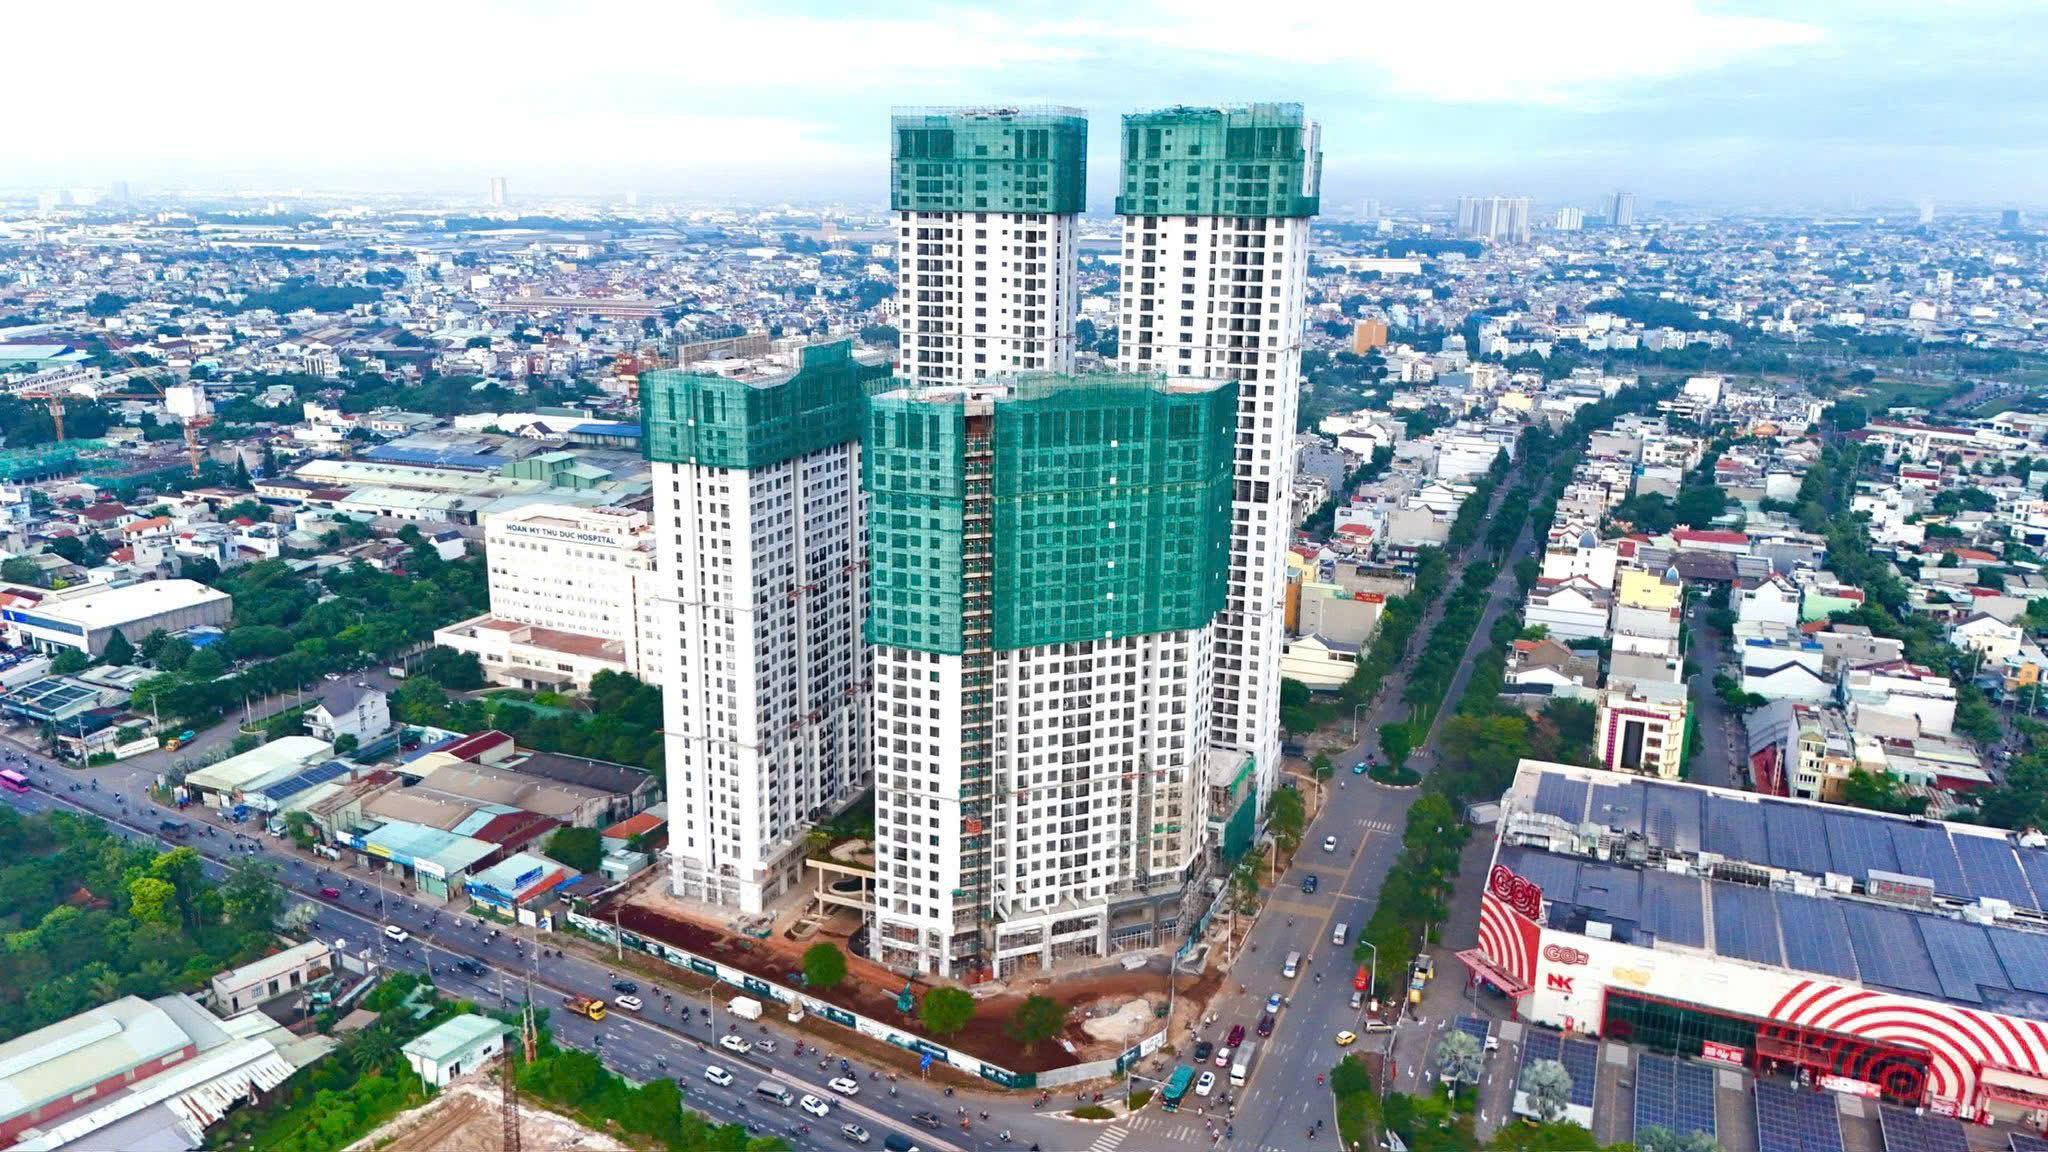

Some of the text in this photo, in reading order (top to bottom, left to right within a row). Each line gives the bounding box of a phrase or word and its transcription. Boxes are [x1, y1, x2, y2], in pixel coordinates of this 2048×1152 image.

[506, 523, 528, 533] HOAN
[542, 528, 558, 537] THU
[559, 531, 575, 539] DUC
[577, 533, 616, 545] HOSPITAL
[1491, 865, 1541, 919] GO!
[1543, 944, 1589, 965] GO!
[1547, 972, 1574, 991] NK
